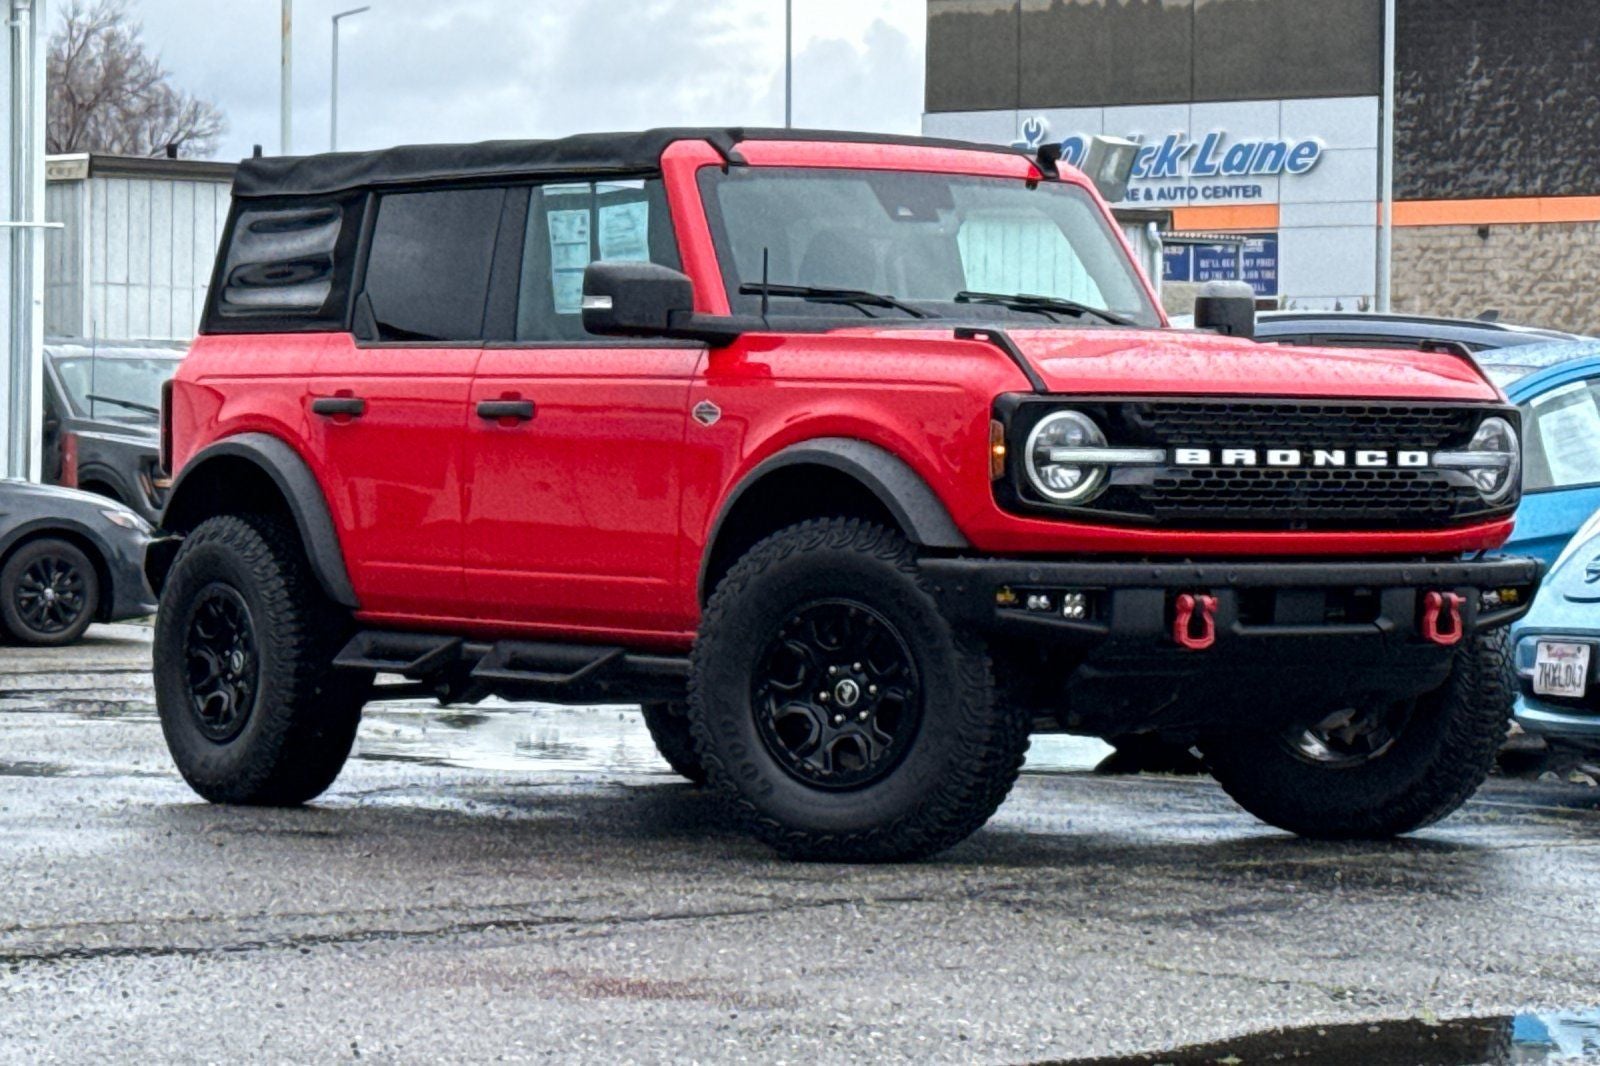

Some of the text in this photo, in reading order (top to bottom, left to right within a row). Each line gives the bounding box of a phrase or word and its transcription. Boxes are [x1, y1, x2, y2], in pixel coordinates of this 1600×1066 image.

[1194, 132, 1321, 176] Lane
[1123, 185, 1262, 201] RE & AUTO CENTER
[1175, 448, 1429, 466] BRONCO
